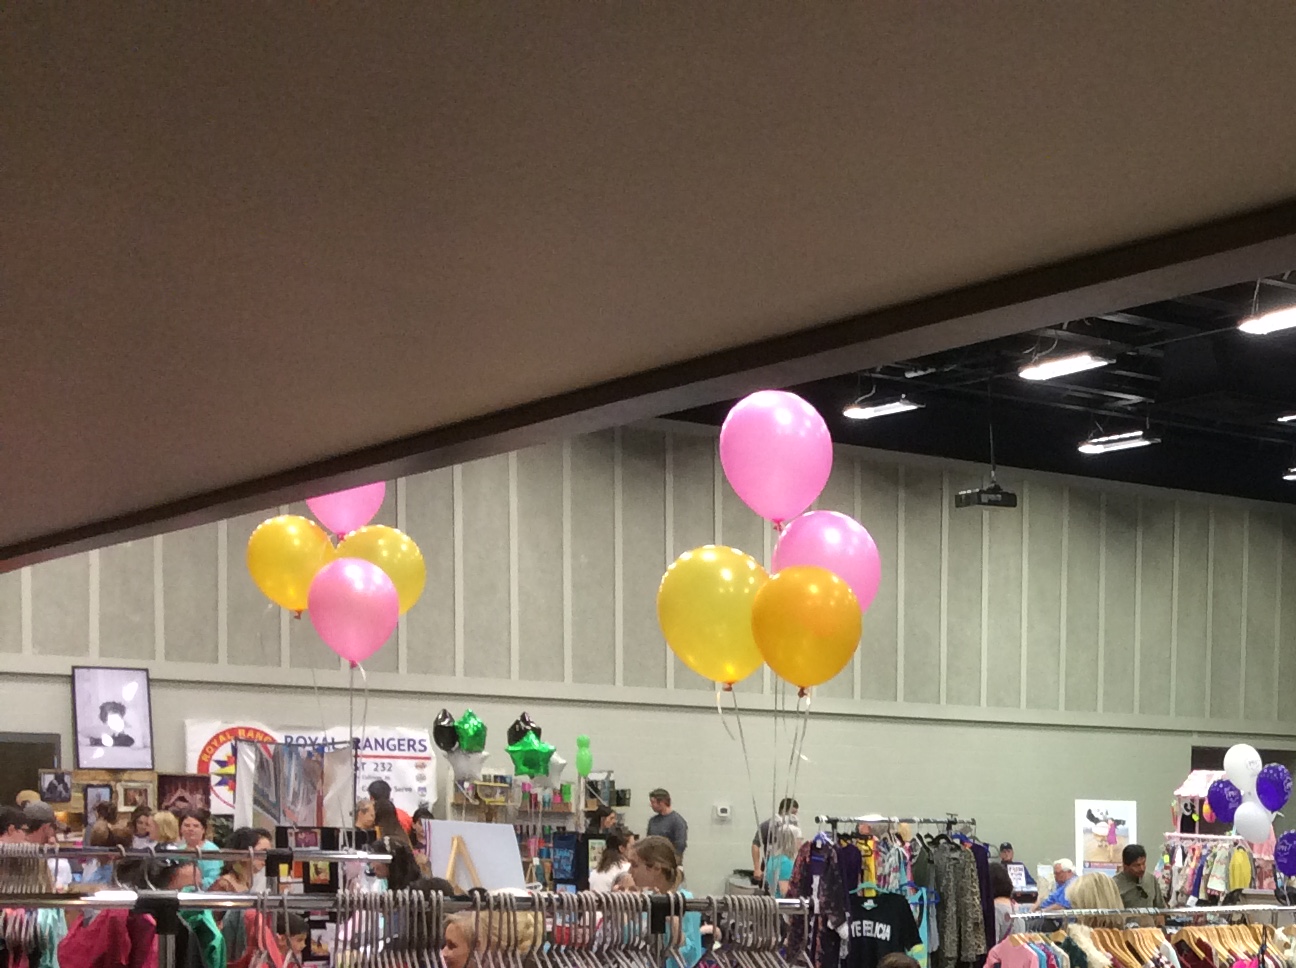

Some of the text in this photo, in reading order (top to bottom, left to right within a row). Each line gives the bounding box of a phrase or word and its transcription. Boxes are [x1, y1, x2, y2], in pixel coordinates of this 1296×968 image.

[201, 731, 234, 762] ROYAL
[284, 735, 428, 753] ROYAL RANGERS
[374, 762, 393, 772] 232
[862, 920, 891, 942] FELICIA
